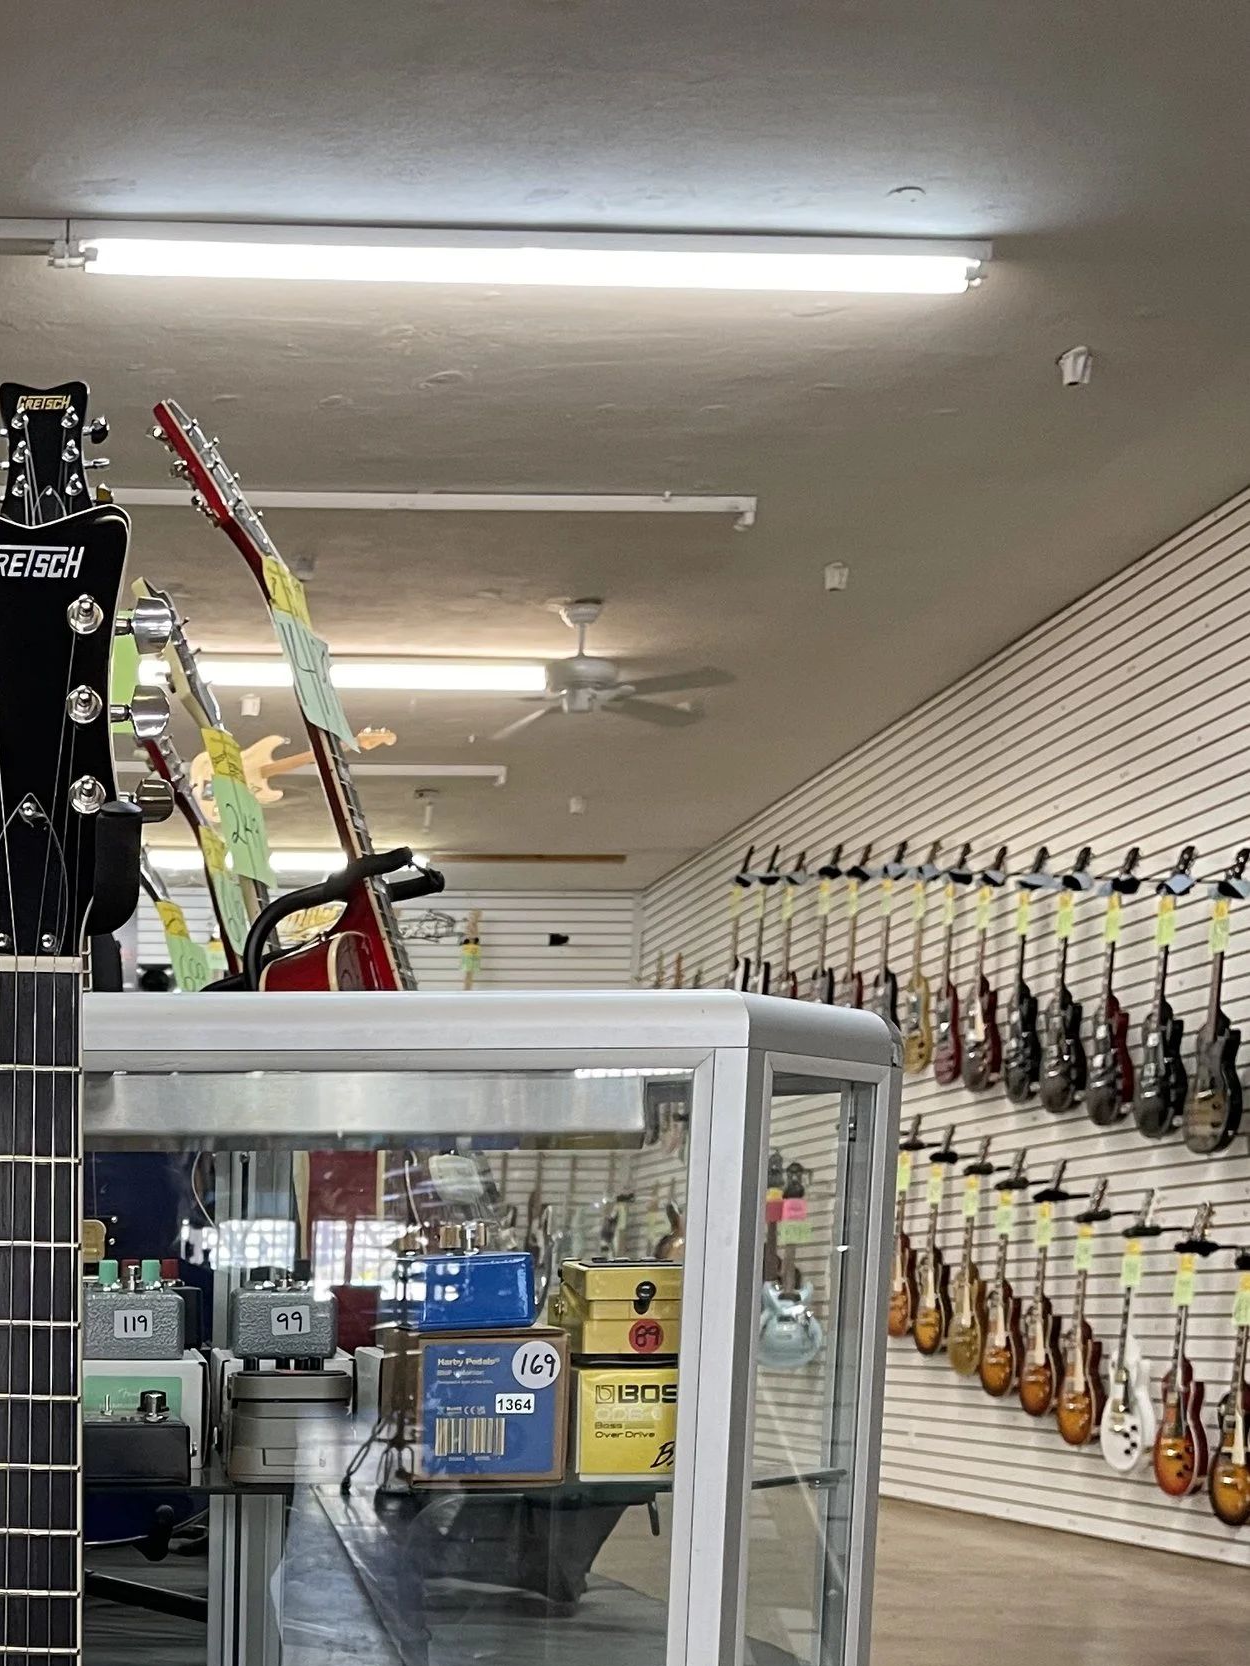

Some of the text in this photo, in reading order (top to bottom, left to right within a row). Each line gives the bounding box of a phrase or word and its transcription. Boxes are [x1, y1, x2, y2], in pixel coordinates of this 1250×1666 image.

[17, 395, 71, 409] GRETSCH
[122, 1314, 149, 1334] 119
[276, 1311, 303, 1333] 99
[634, 1325, 660, 1348] 89
[520, 1352, 557, 1378] 169
[497, 1398, 532, 1412] 1364
[594, 1431, 656, 1439] Over Drive
